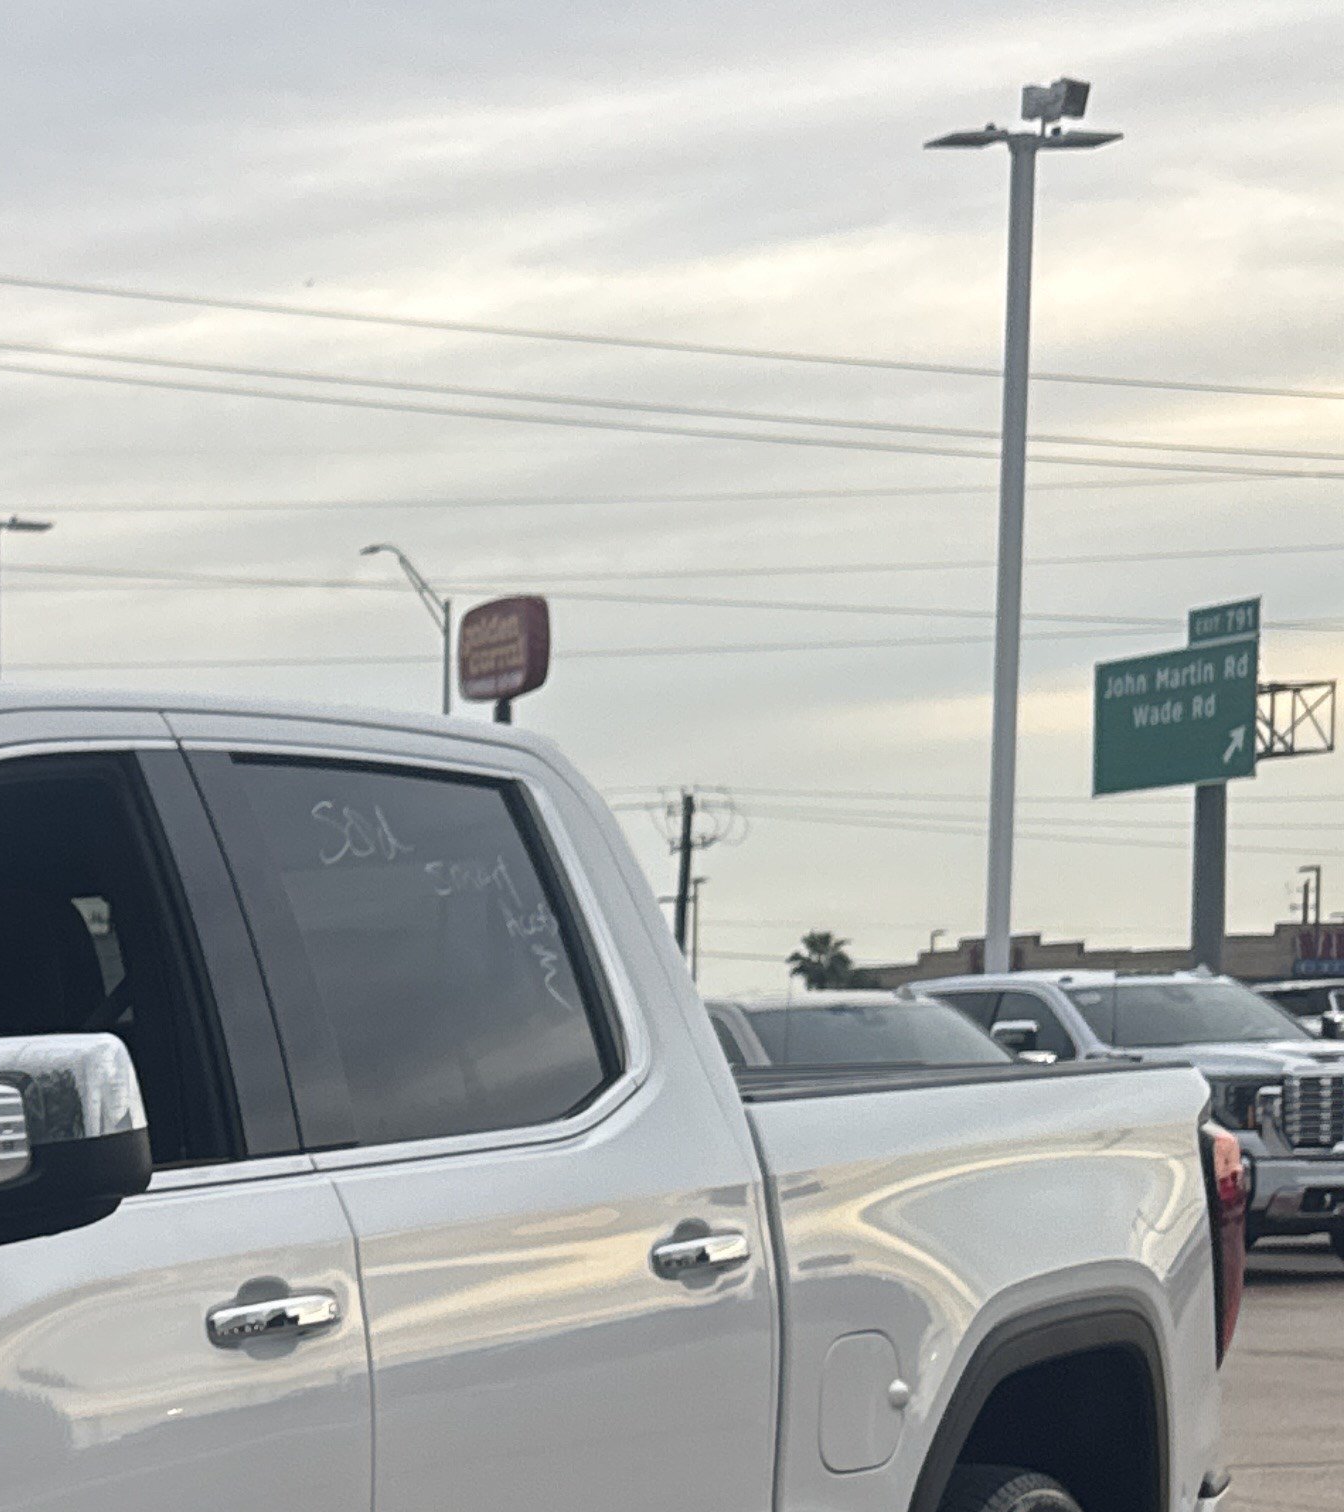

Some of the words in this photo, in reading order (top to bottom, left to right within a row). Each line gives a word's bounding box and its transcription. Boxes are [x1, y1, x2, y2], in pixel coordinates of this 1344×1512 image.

[1226, 608, 1253, 633] 791
[1104, 674, 1147, 699] John
[1156, 659, 1215, 692] Martin
[1224, 653, 1249, 679] Rd
[1133, 702, 1183, 728] Wade
[1192, 694, 1217, 718] Rd
